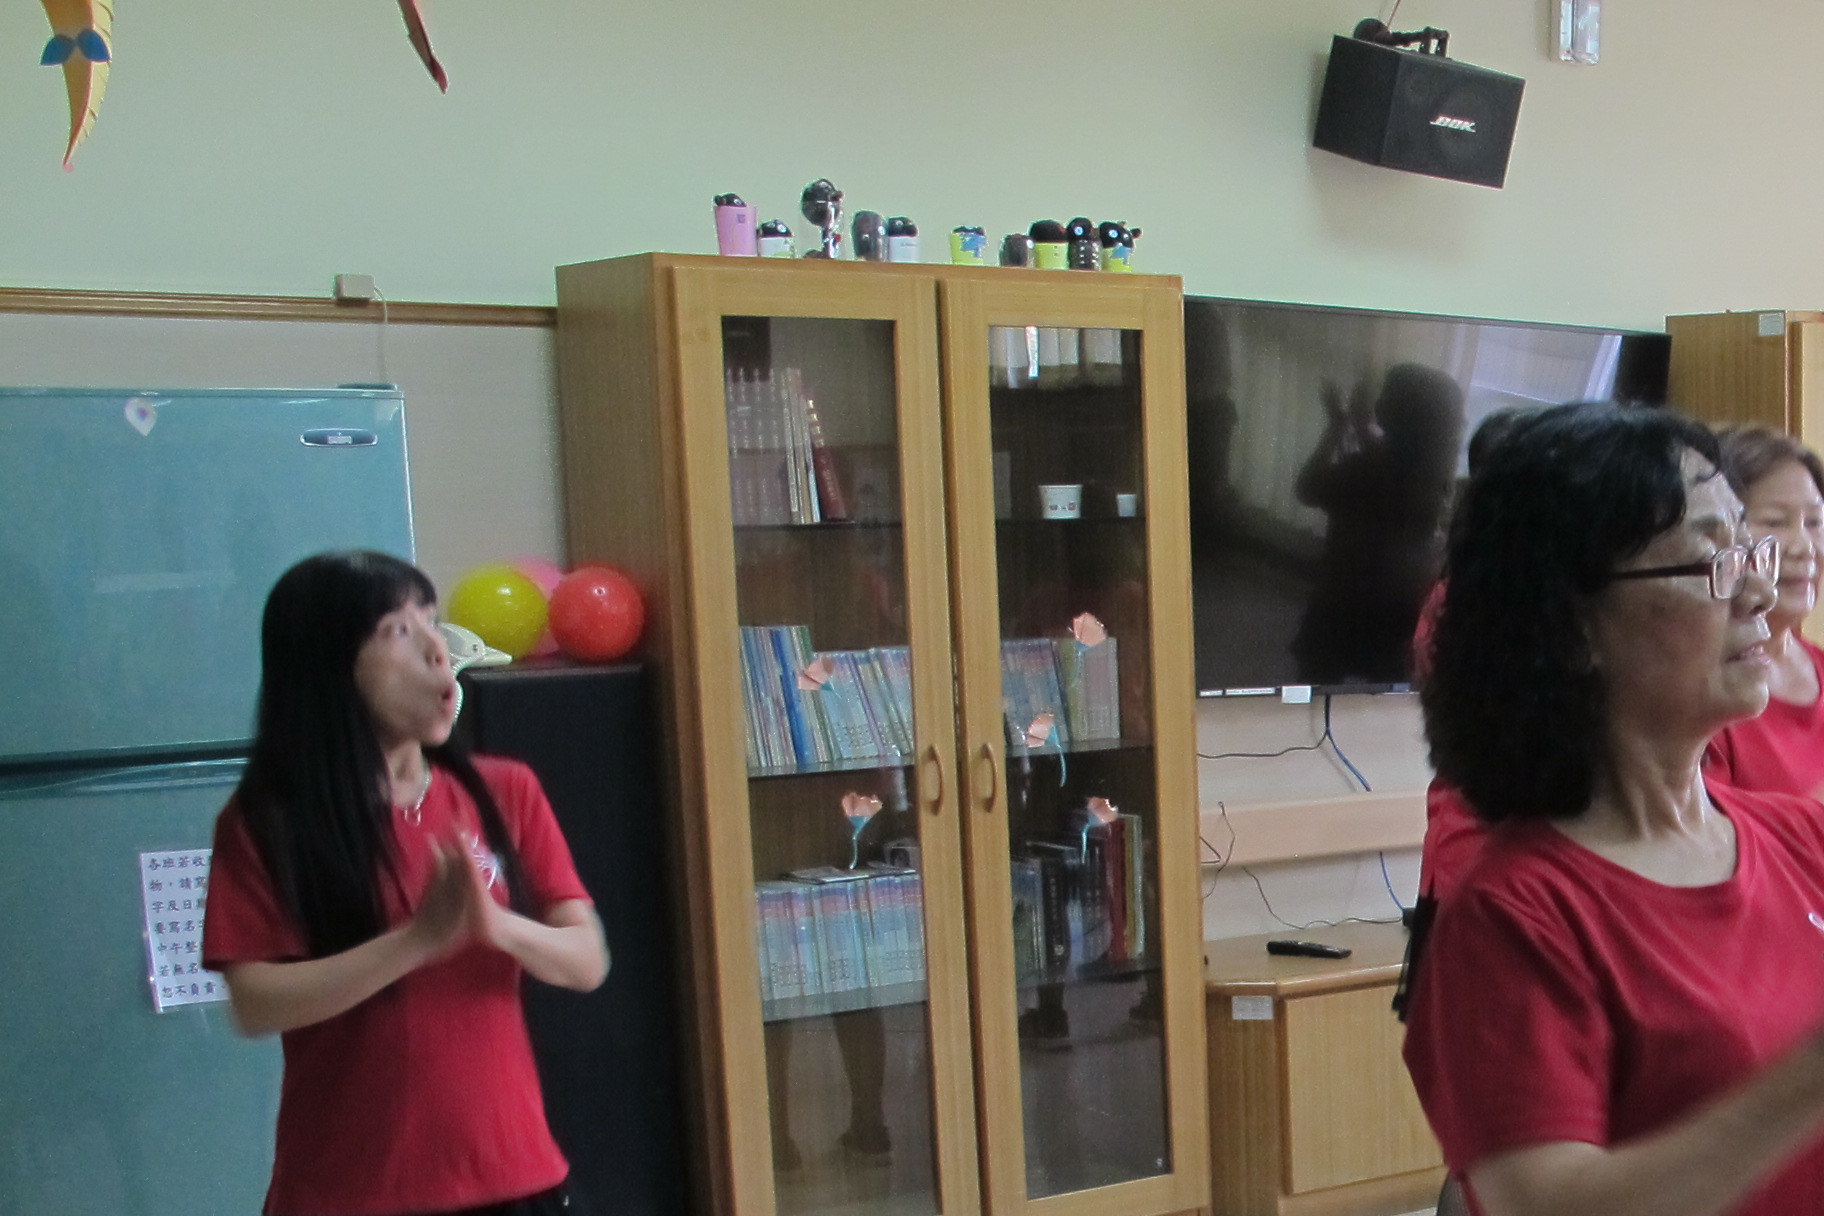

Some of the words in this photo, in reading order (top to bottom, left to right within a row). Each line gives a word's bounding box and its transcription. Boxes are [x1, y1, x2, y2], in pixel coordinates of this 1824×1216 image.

[148, 856, 211, 870] 各班若收
[157, 941, 204, 955] 中午整
[159, 963, 209, 976] 若無名
